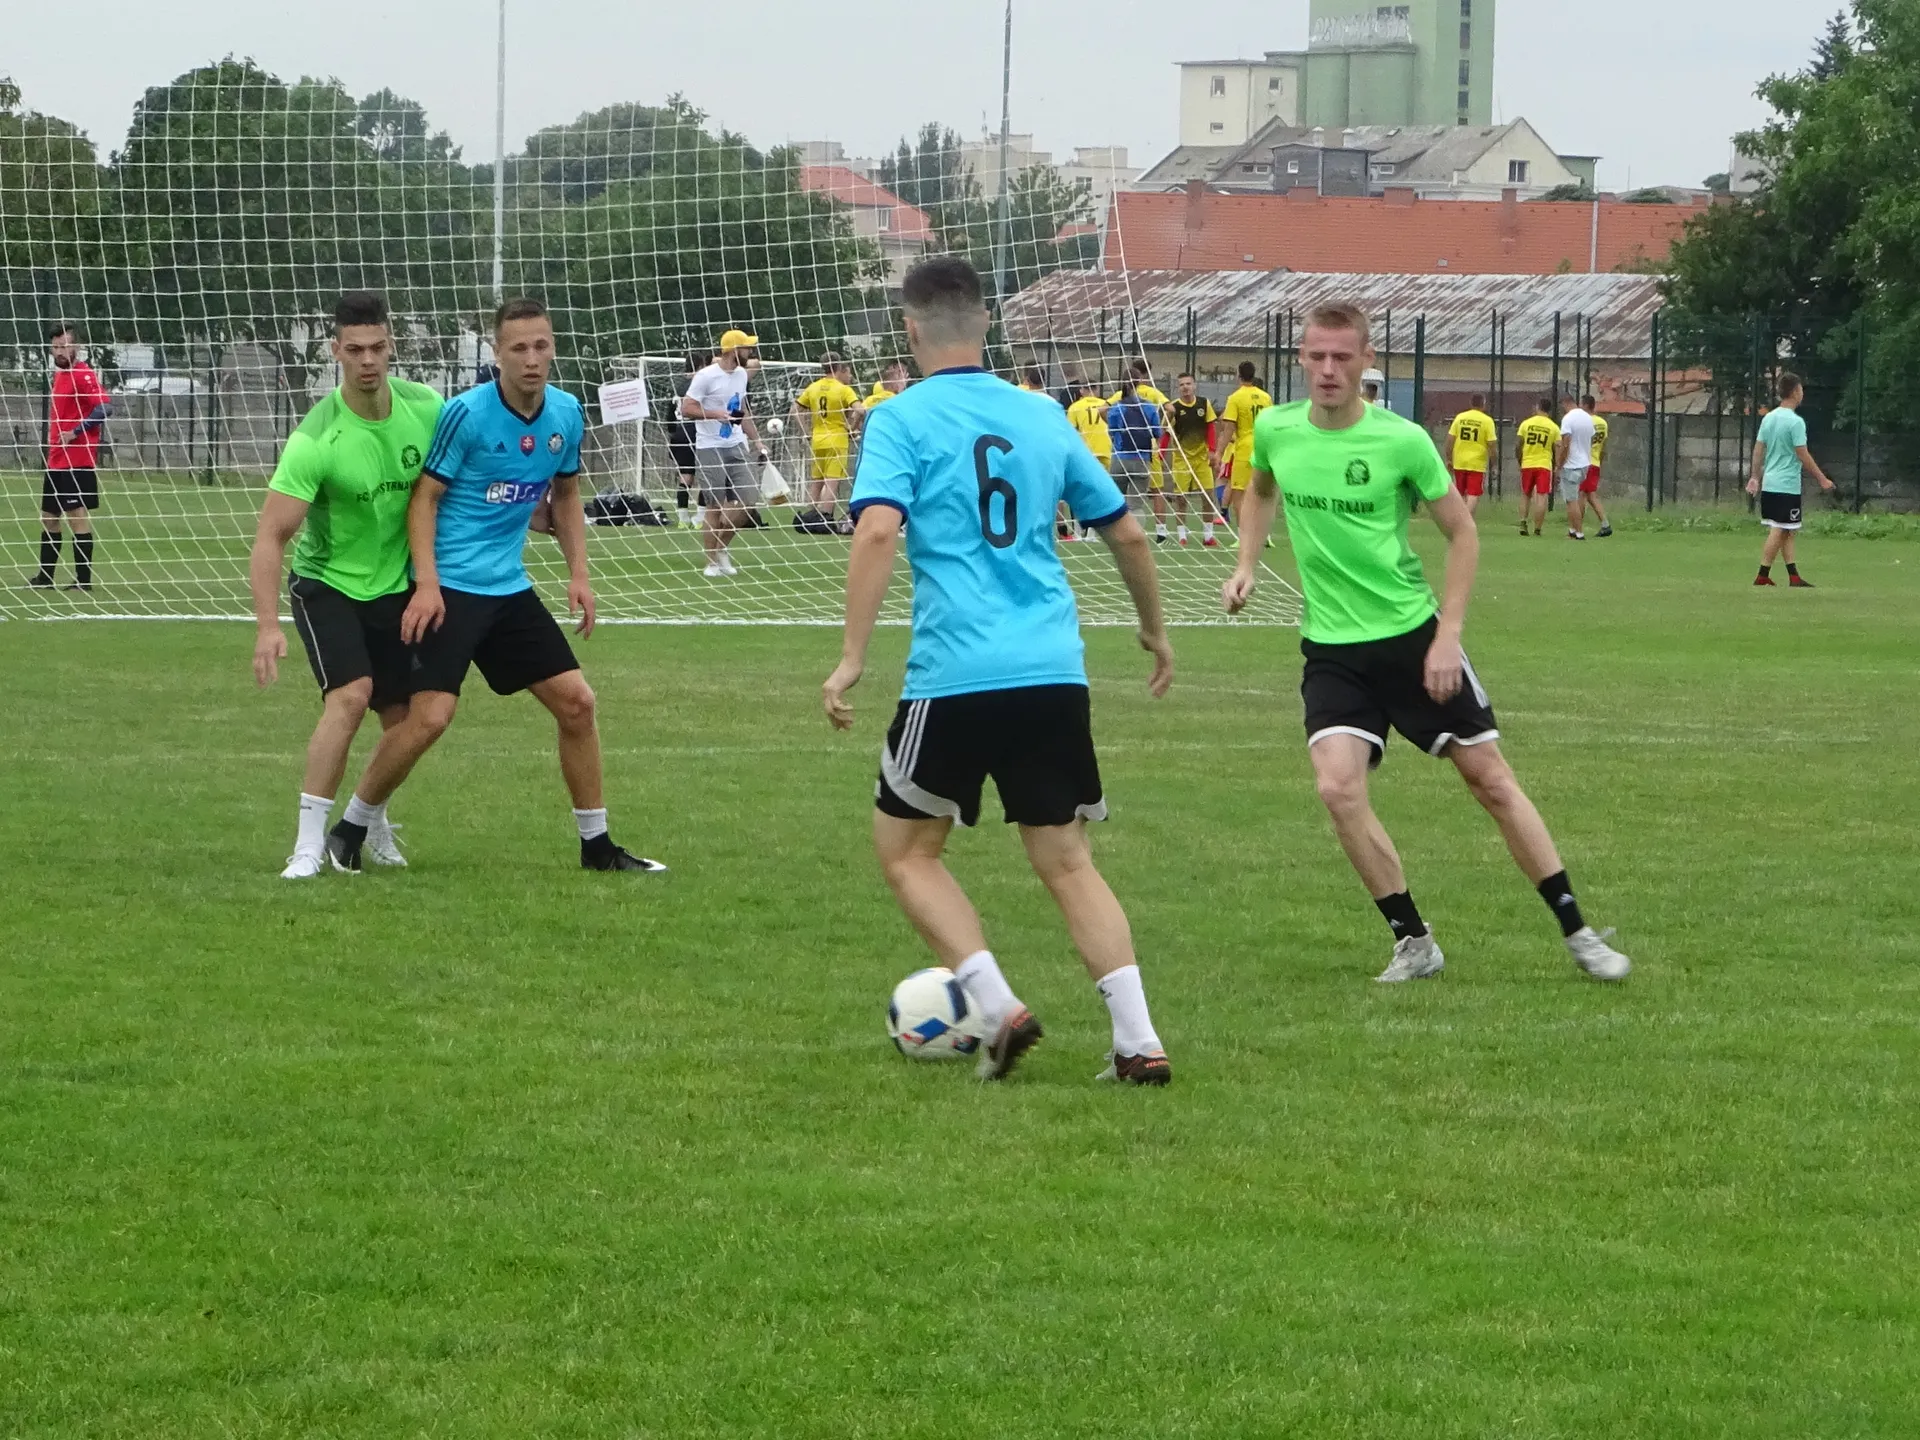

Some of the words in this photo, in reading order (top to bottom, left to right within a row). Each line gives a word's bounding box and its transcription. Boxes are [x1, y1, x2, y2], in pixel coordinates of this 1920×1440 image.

[1460, 427, 1479, 442] 61
[1526, 432, 1549, 448] 24
[973, 433, 1018, 549] 6
